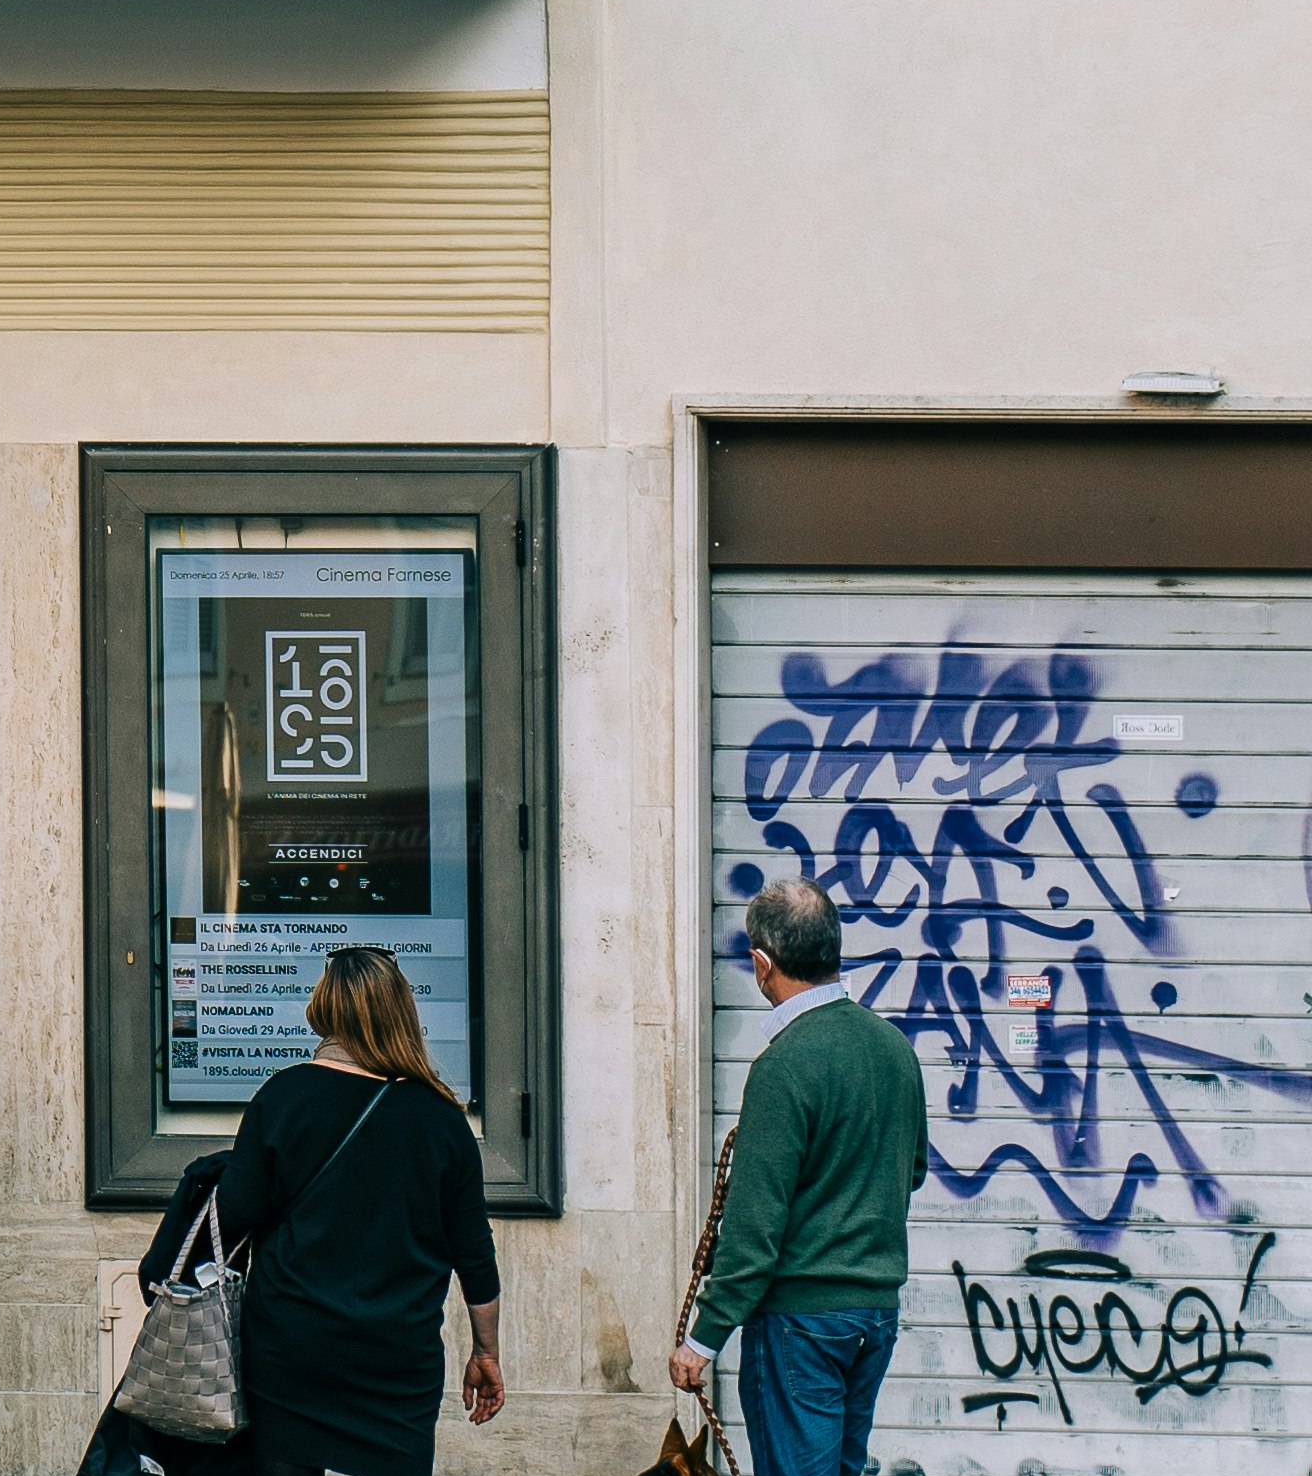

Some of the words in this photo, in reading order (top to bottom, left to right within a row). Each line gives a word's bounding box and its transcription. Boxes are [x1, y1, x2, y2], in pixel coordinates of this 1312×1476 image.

[170, 571, 217, 580] Domenica
[219, 571, 230, 580] 25
[231, 571, 259, 582] Aprile,
[262, 571, 284, 580] 18:57
[316, 567, 382, 583] Cinema
[387, 567, 452, 583] Farnese
[275, 848, 363, 859] ACCENDICI
[200, 923, 210, 933] IL
[212, 923, 258, 934] CINEMA
[260, 924, 281, 934] STA
[283, 924, 348, 934] TORNANDO
[201, 942, 215, 952] Da
[218, 941, 252, 952] Lunedì
[254, 943, 268, 953] 26
[271, 942, 302, 956] Aprile
[394, 943, 432, 953] GIORNI
[201, 964, 224, 975] THE
[226, 964, 298, 975] ROSSELLINIS
[201, 983, 215, 994] Da
[218, 982, 252, 994] Lunedì
[254, 984, 269, 994] 26
[271, 983, 302, 997] Aprile
[201, 1006, 274, 1016] NOMADLAND
[201, 1024, 216, 1035] Da
[218, 1024, 258, 1036] Giovedì
[260, 1025, 274, 1036] 29
[276, 1025, 308, 1038] Aprile
[201, 1047, 245, 1058] #VISITA
[247, 1048, 262, 1058] LA
[264, 1048, 312, 1058] NOSTRA
